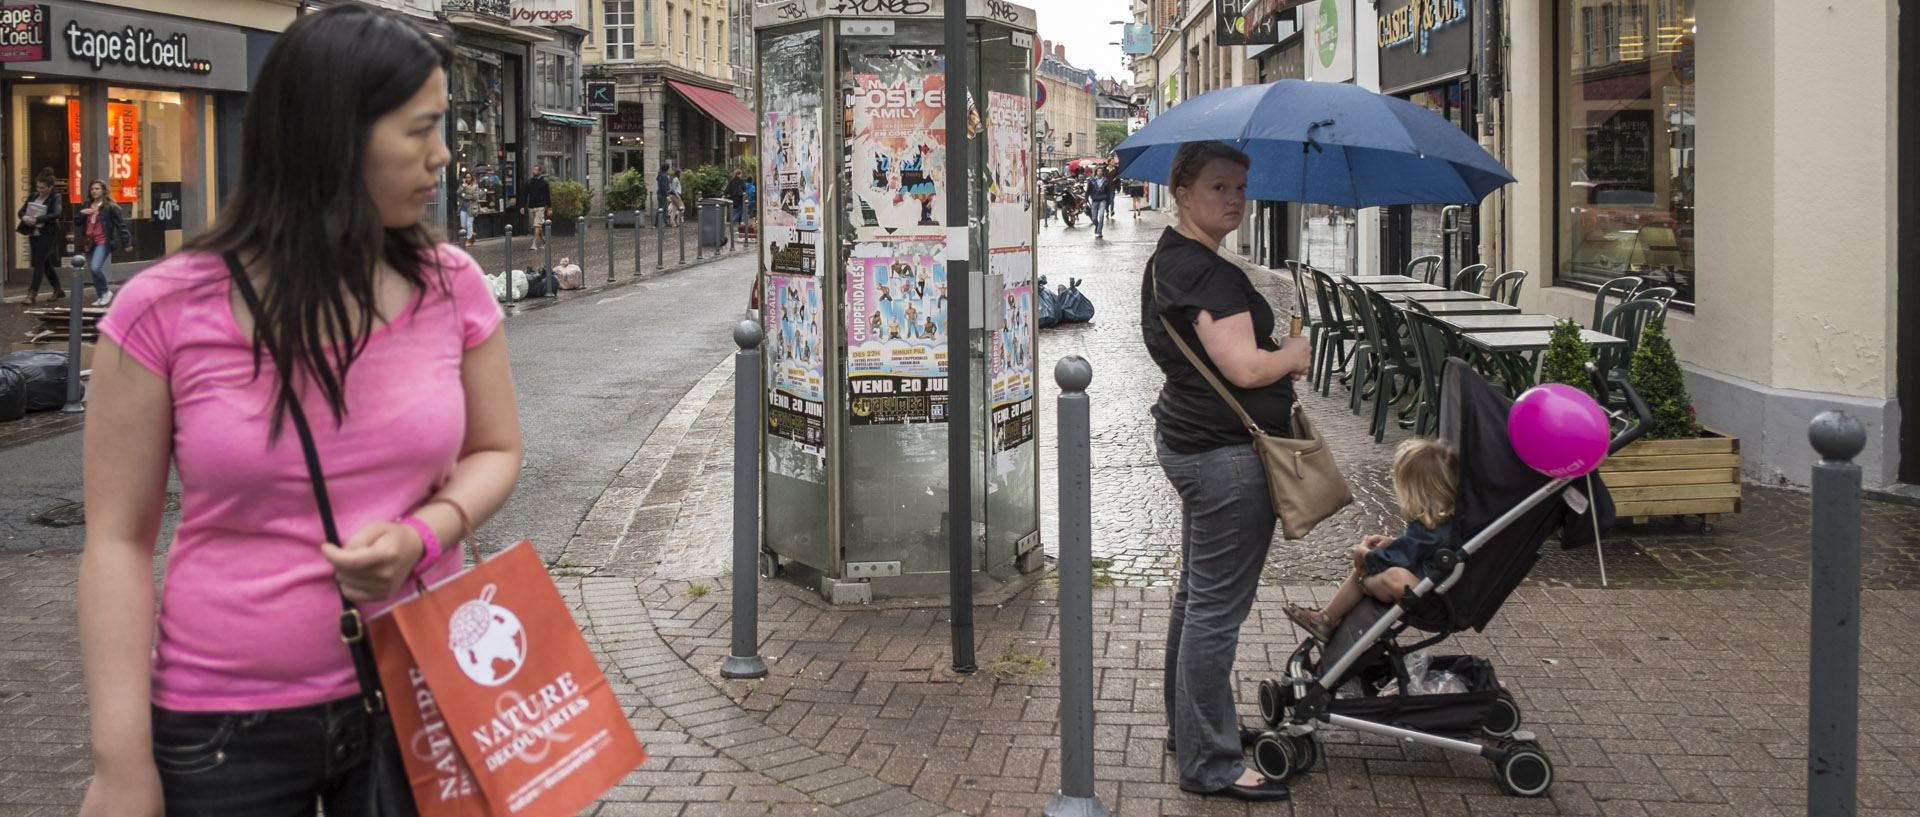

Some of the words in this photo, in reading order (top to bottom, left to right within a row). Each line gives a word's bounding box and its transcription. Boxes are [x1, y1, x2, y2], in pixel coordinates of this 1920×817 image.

[0, 9, 31, 28] ape
[34, 4, 42, 22] à
[513, 7, 573, 23] Voyages
[1378, 5, 1409, 48] CASH
[67, 24, 121, 67] tape
[124, 28, 136, 62] à
[122, 109, 134, 154] SOLDEN
[123, 187, 136, 197] SALE
[154, 199, 179, 220] -60%
[853, 265, 866, 341] CHIPPENDALES
[851, 380, 897, 394] VEND.
[900, 379, 921, 392] 20
[792, 398, 803, 412] 20
[805, 401, 822, 417] JUIN
[472, 671, 579, 754] NATURE
